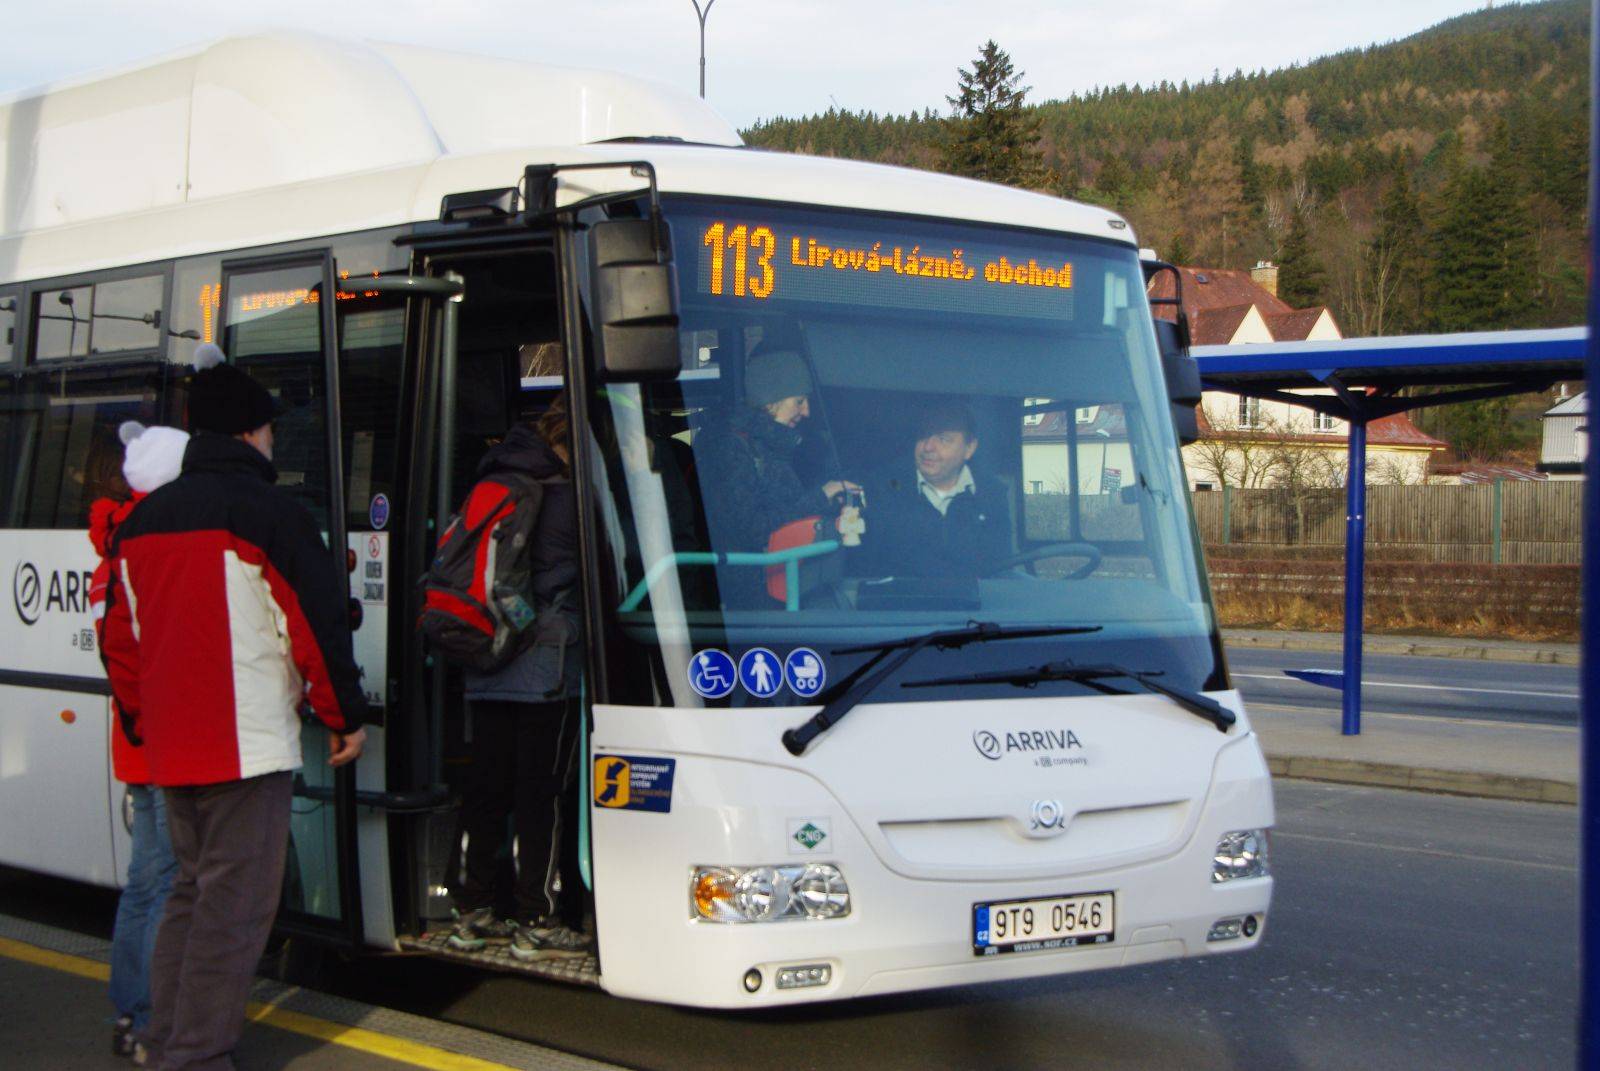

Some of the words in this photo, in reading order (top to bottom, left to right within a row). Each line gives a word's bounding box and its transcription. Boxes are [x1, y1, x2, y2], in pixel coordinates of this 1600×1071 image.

[704, 222, 776, 298] 113
[984, 257, 1073, 288] obchod
[1006, 730, 1083, 752] ARRIVA
[995, 907, 1034, 937] 9T9
[1052, 901, 1102, 932] 0546
[977, 930, 989, 941] CZ
[1013, 937, 1079, 952] www.sor.cz
